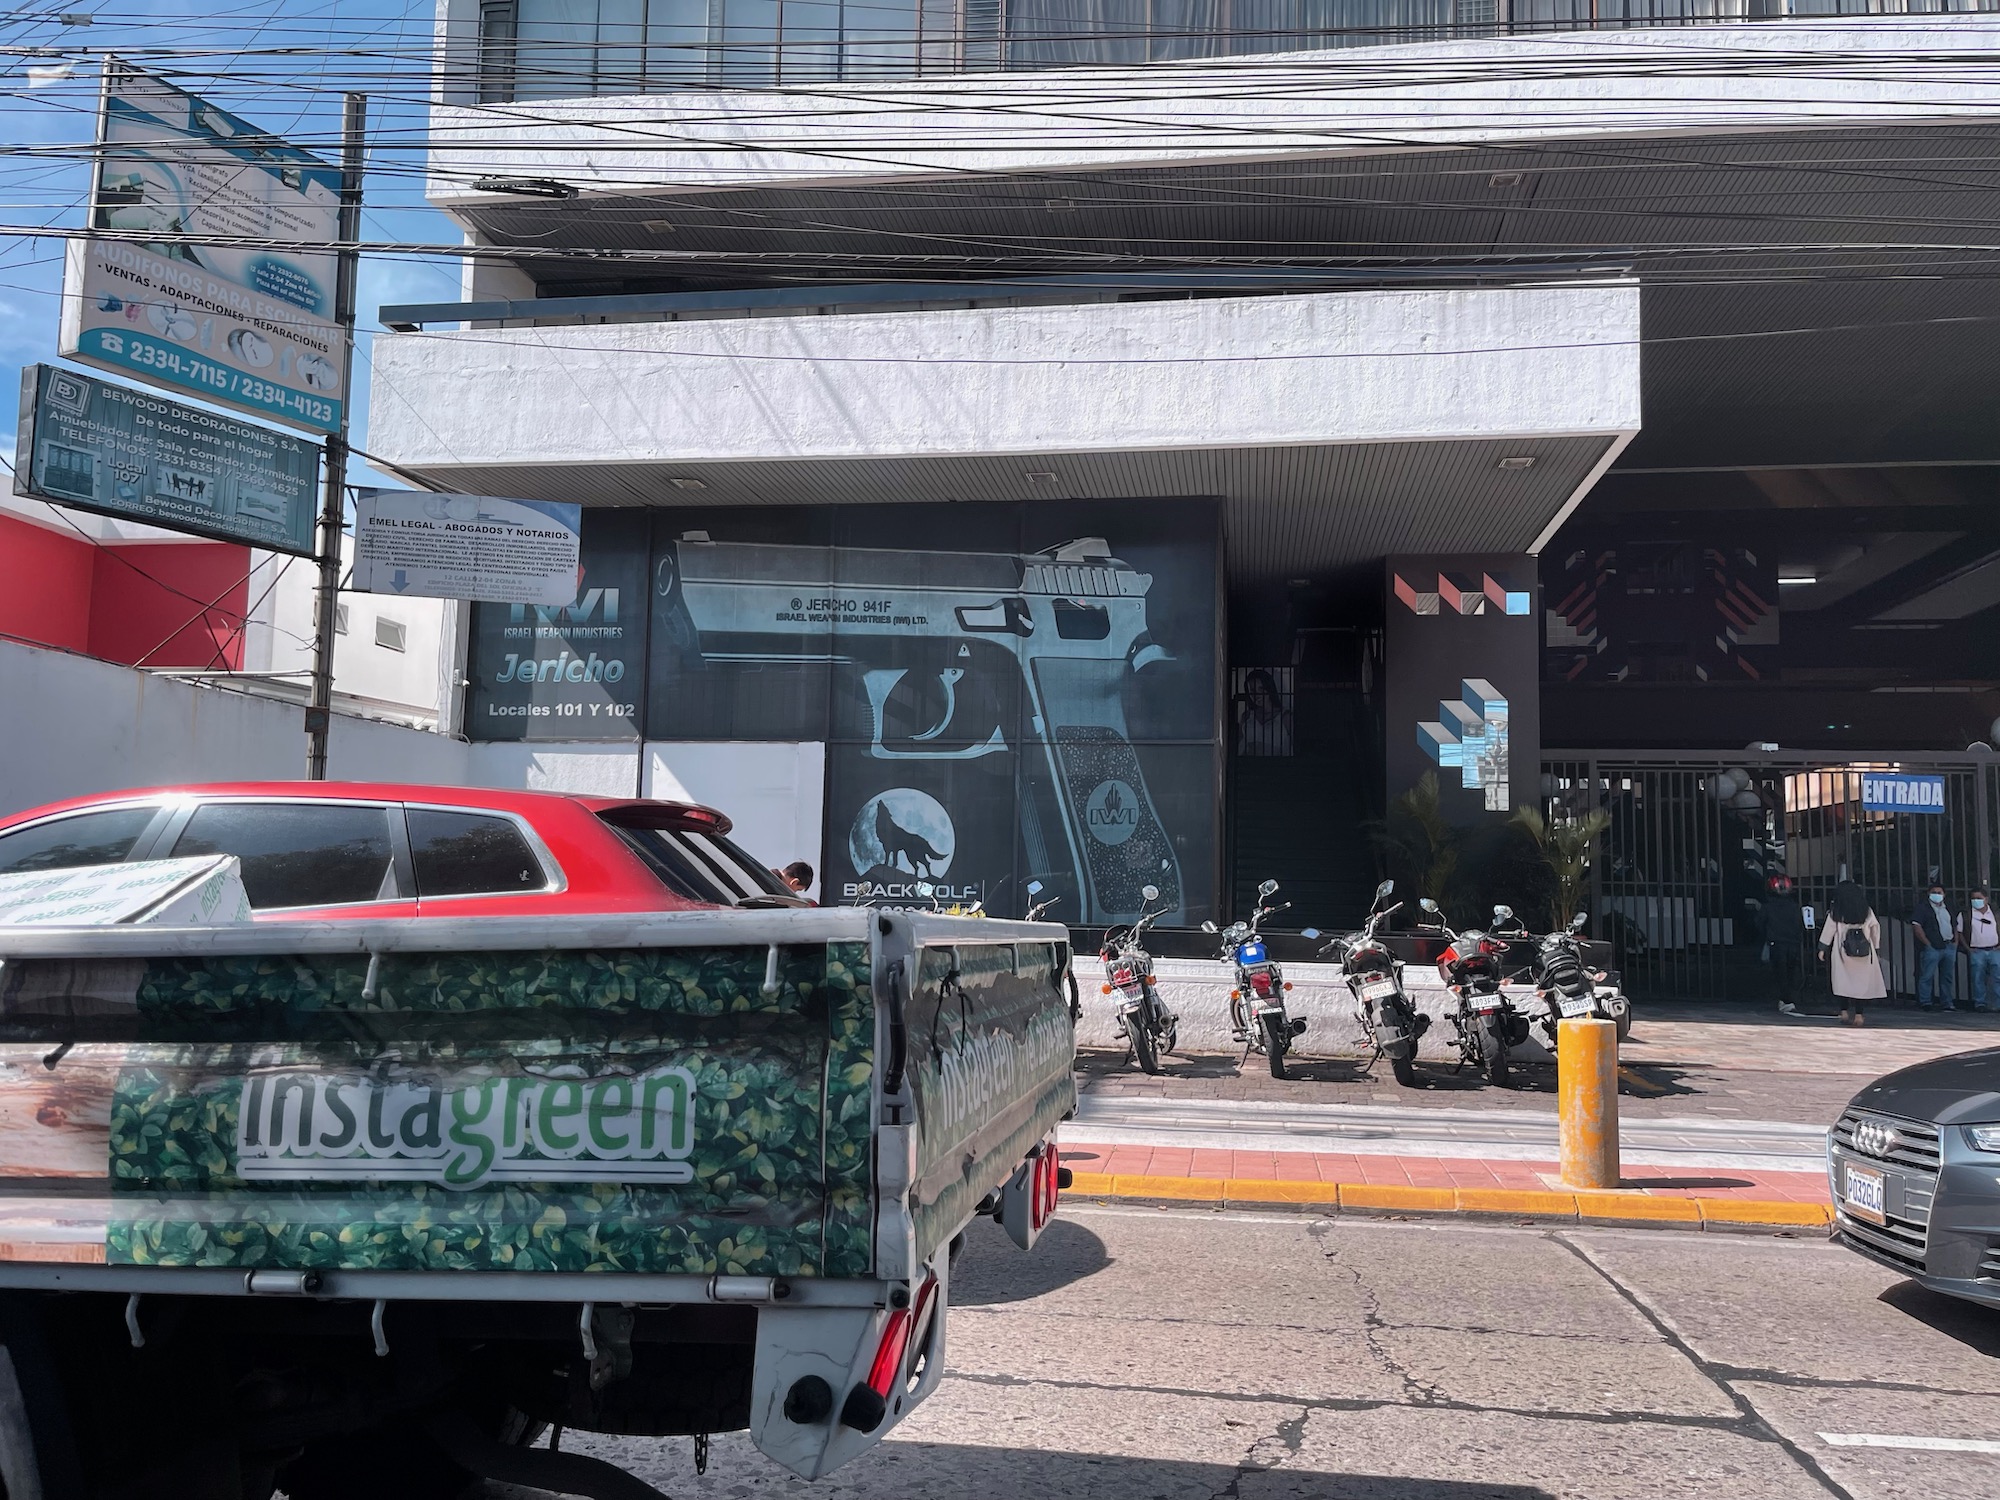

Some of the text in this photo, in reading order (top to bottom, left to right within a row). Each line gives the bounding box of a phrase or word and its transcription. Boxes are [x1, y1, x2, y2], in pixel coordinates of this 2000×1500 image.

[94, 241, 204, 293] AUDIFONOS
[207, 282, 252, 313] PARA
[256, 301, 339, 345] ESCUCHAR
[104, 262, 150, 288] VENTAS
[160, 284, 245, 323] ADAPTACIONES
[253, 318, 329, 353] REPARACIONES
[130, 341, 228, 390] 2334-7115
[242, 377, 333, 423] 2334-4123
[102, 387, 303, 455] BEWOOD DECORACIONES, S.A.
[49, 410, 131, 440] Amueblados
[189, 447, 247, 472] Comedor,
[60, 426, 151, 458] TELEFONOS:
[154, 451, 222, 476] 2331-8354
[135, 414, 274, 461] De todo para el hogar
[107, 457, 149, 475] Local
[114, 469, 142, 484] 107
[110, 498, 157, 515] CORREO:
[145, 495, 291, 536] Bewood Decoraciones, S.A.
[369, 517, 570, 540] EMEL LEGAL ABOGADOS Y NOTARIOS
[776, 613, 807, 622] ISRAEL
[842, 614, 892, 625] INDUSTRIES
[912, 616, 929, 625] LTD.
[806, 599, 892, 613] JERICHO 941F
[504, 627, 623, 639] ISRAEL WEAPON INDUSTRIES
[495, 651, 625, 683] Jericho
[489, 703, 635, 717] Locales 101 Y 102
[1863, 780, 1944, 807] ENTRADA
[1090, 807, 1137, 826] IWI
[245, 1068, 694, 1184] instagreen
